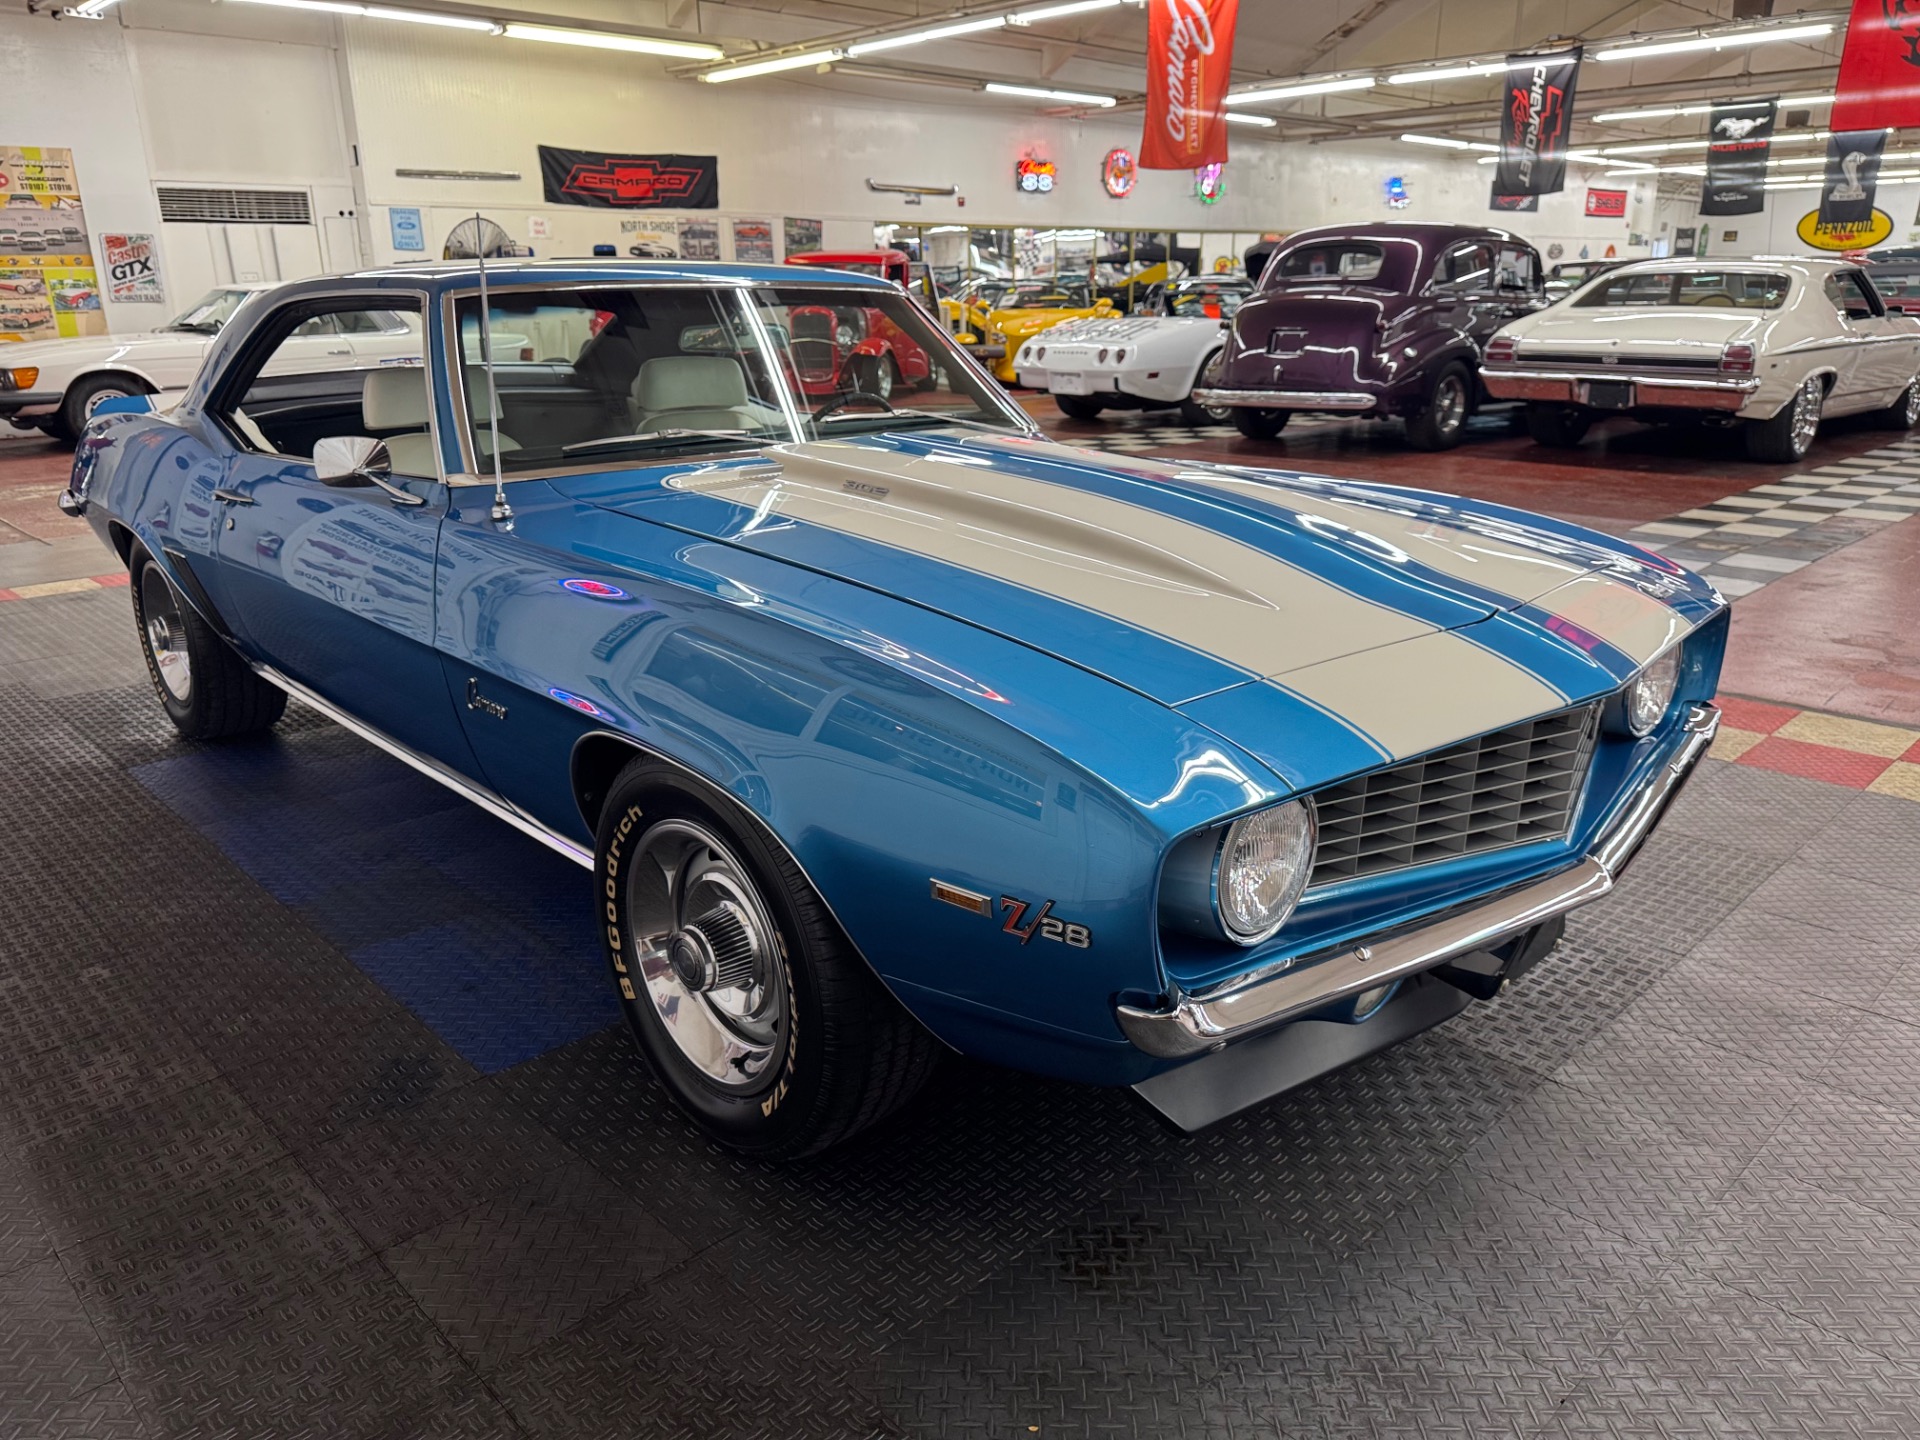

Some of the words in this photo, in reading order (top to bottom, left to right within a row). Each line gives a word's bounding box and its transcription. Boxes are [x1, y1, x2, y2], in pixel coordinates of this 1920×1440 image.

[1166, 0, 1215, 142] Camaro
[1190, 59, 1198, 74] BY
[1518, 65, 1547, 188] CHEVROLET
[1711, 140, 1768, 152] MUSTANG
[582, 175, 683, 186] CAMARO
[620, 220, 648, 234] NORTH
[649, 220, 676, 235] SHORE
[1813, 220, 1875, 236] PENNZOIL
[111, 255, 153, 280] GTX
[605, 804, 644, 1001] BFGoodrich
[1000, 894, 1092, 949] Z/28
[761, 1078, 789, 1118] T/A
